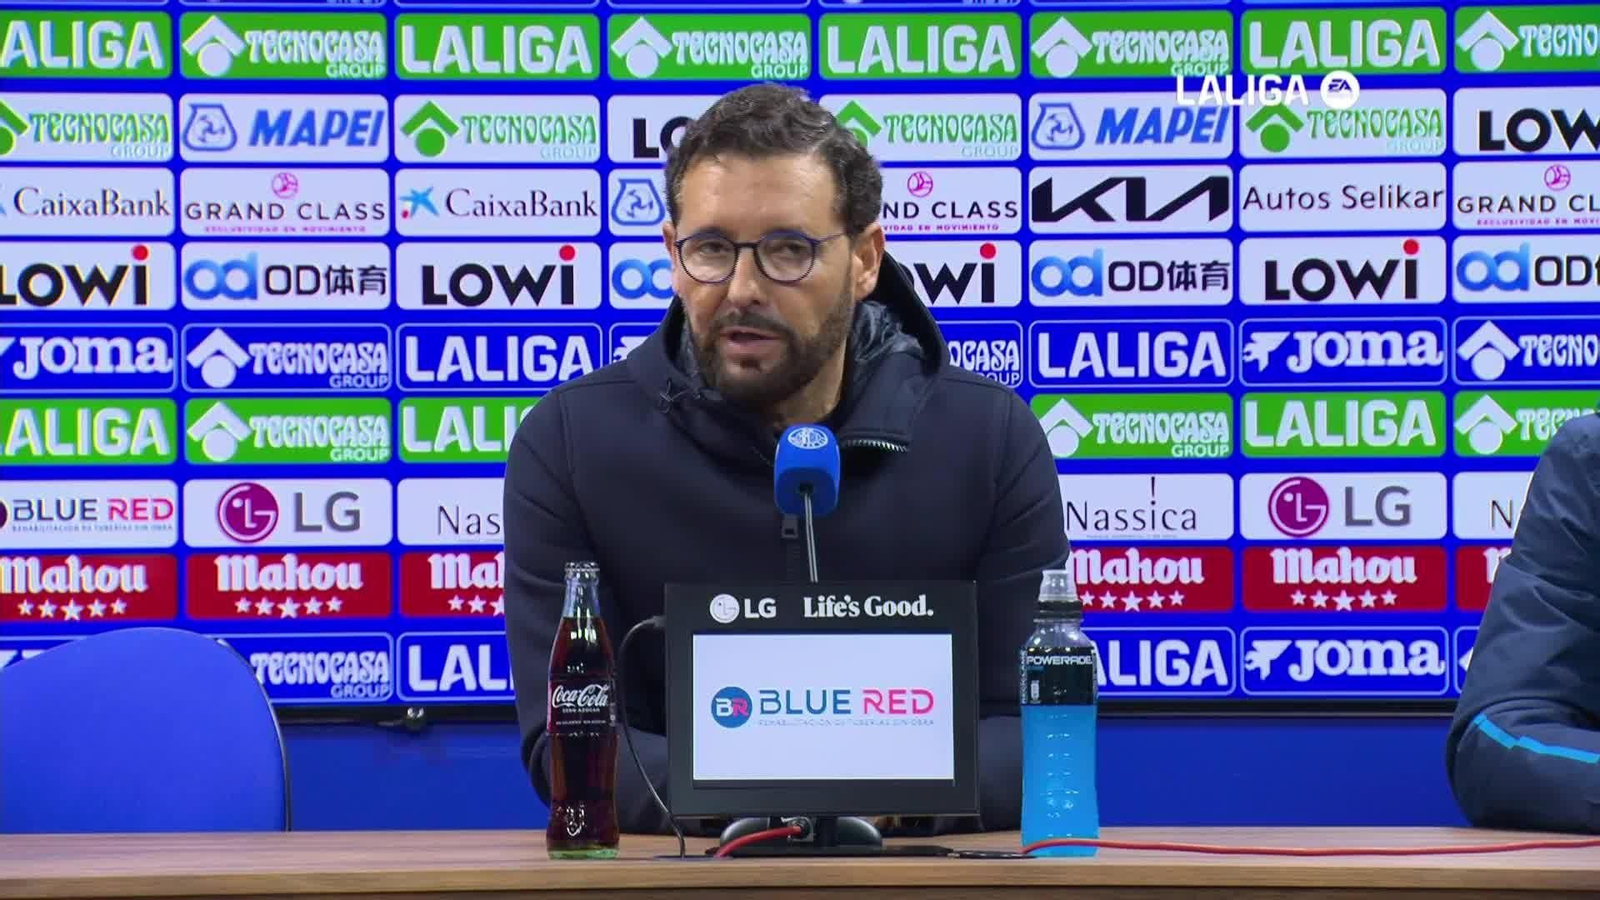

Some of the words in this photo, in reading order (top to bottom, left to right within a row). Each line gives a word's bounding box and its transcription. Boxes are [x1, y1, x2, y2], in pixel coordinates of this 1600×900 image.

[0, 20, 164, 68] ALIGA
[245, 30, 386, 64] TECNOCASA
[401, 25, 593, 74] LALIGA
[671, 31, 808, 65] TECNOCASA
[827, 25, 1016, 73] LALIGA
[1091, 30, 1229, 64] TECNOCASA
[1248, 19, 1441, 69] LALIGA
[1517, 24, 1600, 57] TECNO
[326, 62, 386, 78] GROUP
[751, 64, 808, 79] GROUP
[1170, 62, 1229, 77] GROUP
[28, 112, 170, 143] TECNOCASA
[248, 109, 386, 147] MAPEI
[461, 114, 597, 144] TECNOCASA
[883, 113, 1018, 144] TECNOCASA
[1095, 106, 1230, 145] MAPEI
[1307, 107, 1444, 138] TECNOCASA
[1479, 108, 1600, 153] LOW
[110, 144, 171, 159] GROUP
[540, 145, 597, 159] GROUP
[961, 145, 1018, 158] GROUP
[1385, 139, 1444, 154] GROUP
[13, 187, 171, 218] CaixaBank
[186, 203, 285, 220] GRAND
[297, 202, 385, 220] CLASS
[446, 187, 598, 218] CaixaBank
[931, 200, 1018, 219] CLASS
[1242, 186, 1331, 210] Autos
[1341, 184, 1445, 210] Selikar
[1457, 195, 1556, 213] GRAND
[248, 342, 389, 375] TECNOCASA
[405, 335, 595, 382] LALIGA
[948, 340, 1020, 371] OCASA
[1038, 331, 1227, 378] LALIGA
[1518, 333, 1600, 368] TECNO
[329, 373, 390, 388] GROUP
[0, 408, 171, 456] ALIGA
[249, 415, 389, 449] TECNOCASA
[402, 406, 531, 453] LALI
[1091, 412, 1230, 445] TECNOCASA
[1244, 399, 1437, 448] LALIGA
[329, 446, 390, 462] GROUP
[1171, 443, 1230, 458] GROUP
[12, 498, 98, 521] BLUE
[107, 498, 174, 521] RED
[294, 491, 361, 533] LG
[1066, 476, 1197, 532] Nassica
[1343, 486, 1412, 527] LG
[0, 554, 149, 594] Mahou
[214, 553, 364, 592] Mahou
[1067, 547, 1205, 585] Mahou
[1269, 546, 1418, 585] Mahou
[744, 598, 777, 619] LG
[803, 595, 861, 618] Life's
[864, 594, 935, 617] Good.
[250, 651, 390, 685] TECNOCASA
[408, 644, 514, 691] LAL
[1026, 655, 1093, 665] POWERADE
[330, 684, 391, 698] GROUP
[552, 684, 610, 708] Coca-Cola
[759, 688, 852, 716] BLUE
[861, 688, 935, 716] RED
